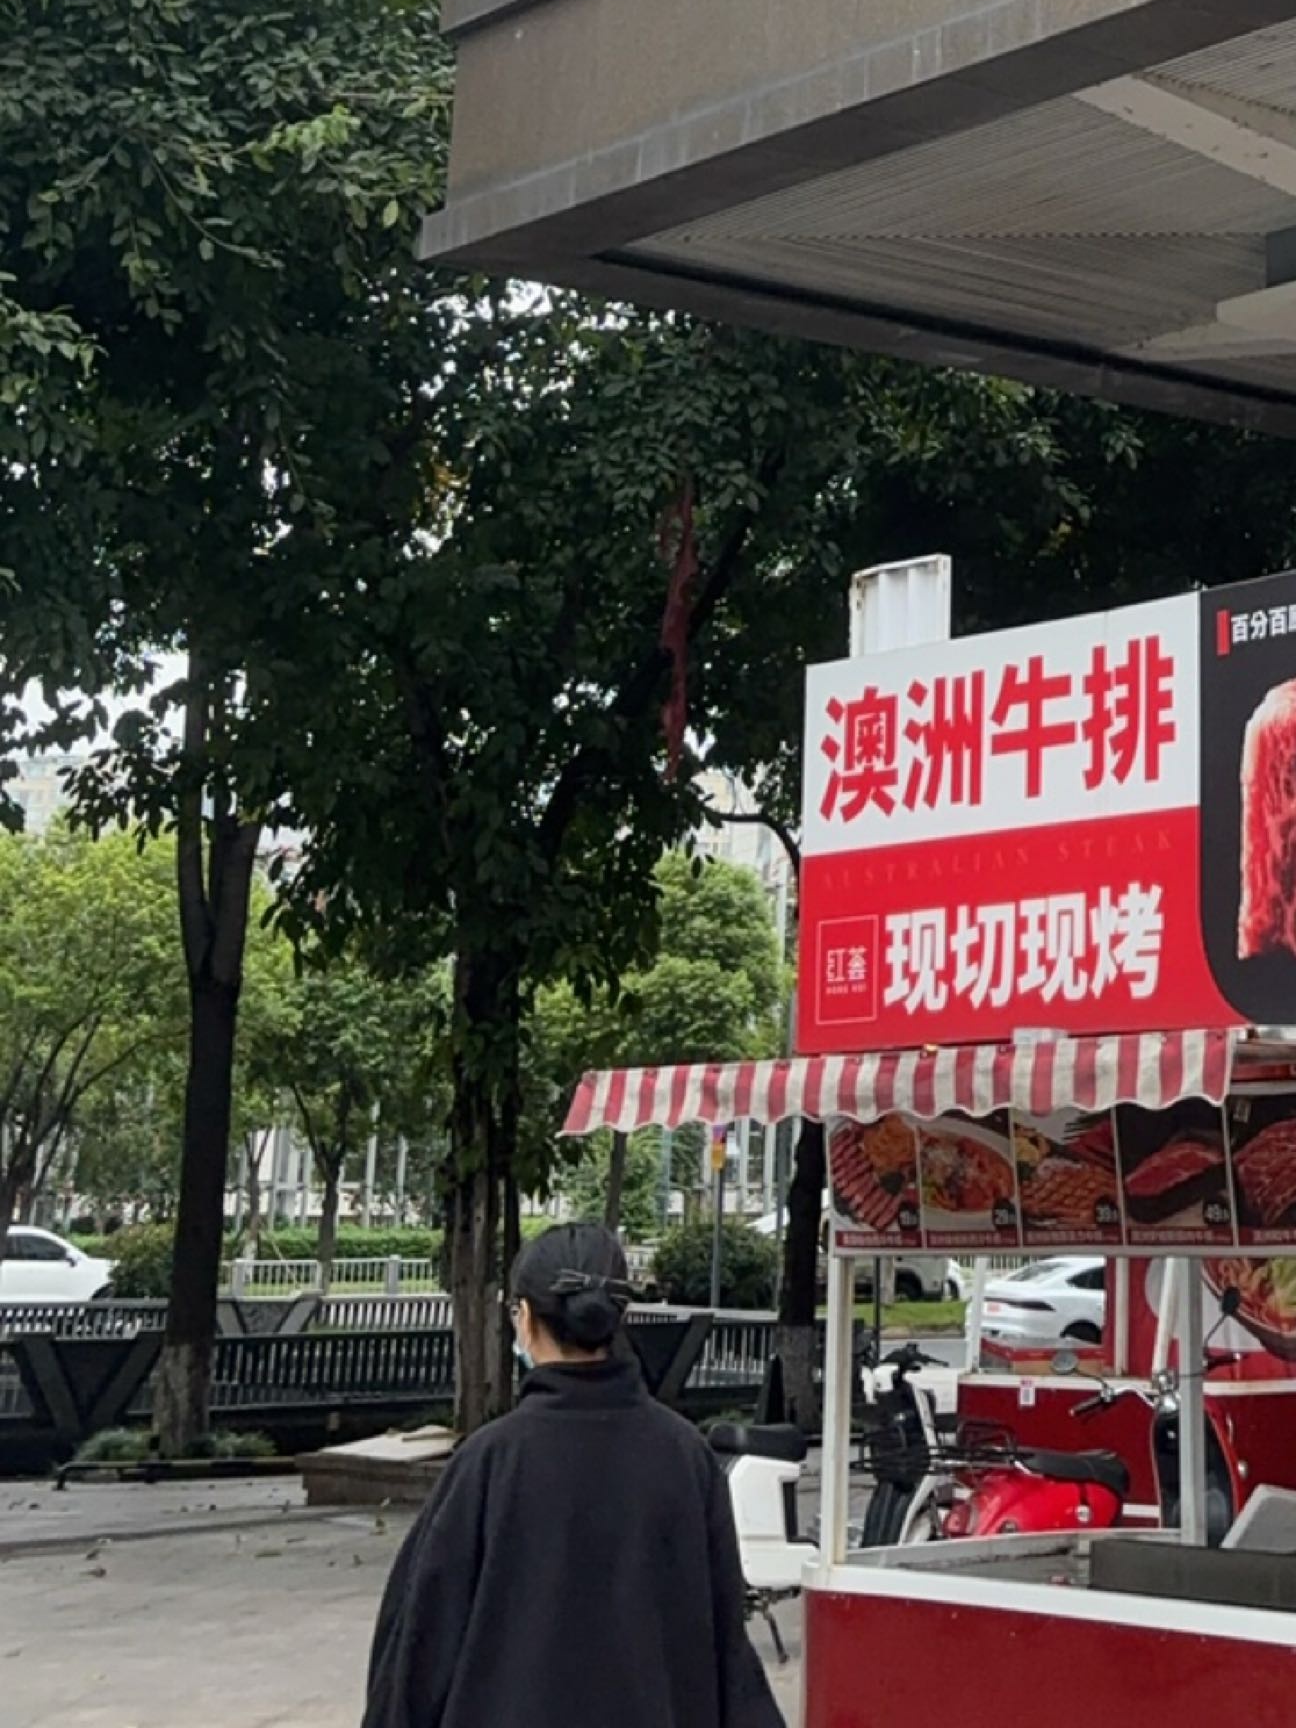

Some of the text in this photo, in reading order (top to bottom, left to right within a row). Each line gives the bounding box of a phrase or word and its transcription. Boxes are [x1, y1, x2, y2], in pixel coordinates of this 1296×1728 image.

[819, 635, 1177, 822] 澳洲牛排
[884, 881, 1165, 1015] 现切现烤
